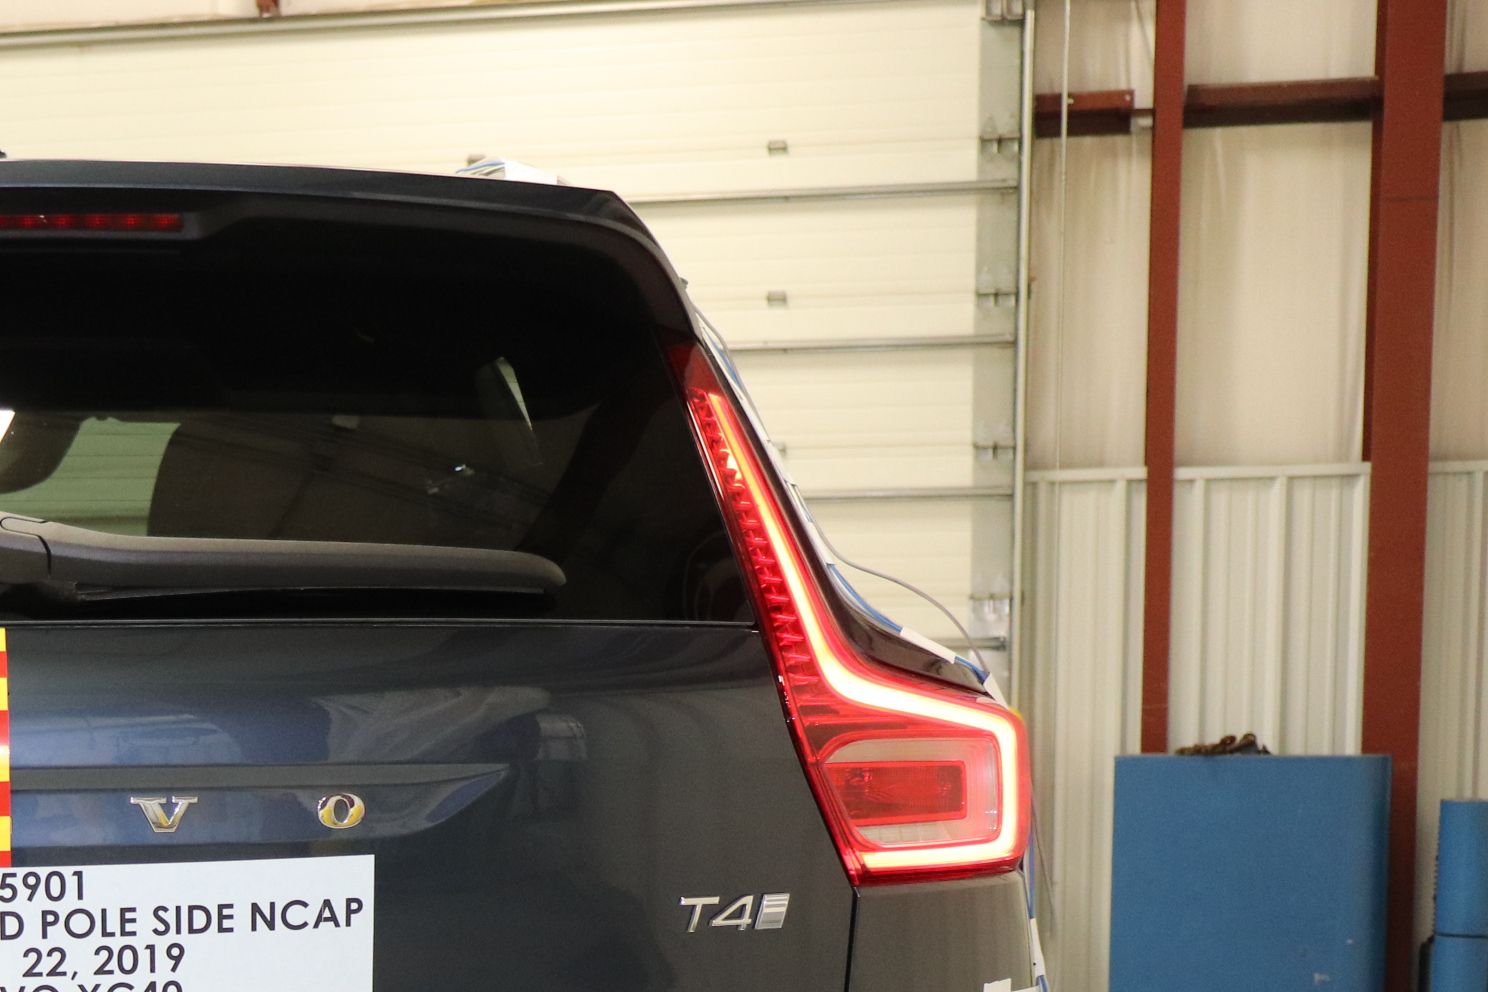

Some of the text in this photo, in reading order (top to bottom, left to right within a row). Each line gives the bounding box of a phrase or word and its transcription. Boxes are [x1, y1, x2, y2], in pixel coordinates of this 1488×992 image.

[41, 906, 137, 940] POLE
[151, 903, 234, 937] SIDE
[250, 897, 364, 932] NCAP
[22, 946, 78, 981] 22,
[93, 942, 185, 976] 2019
